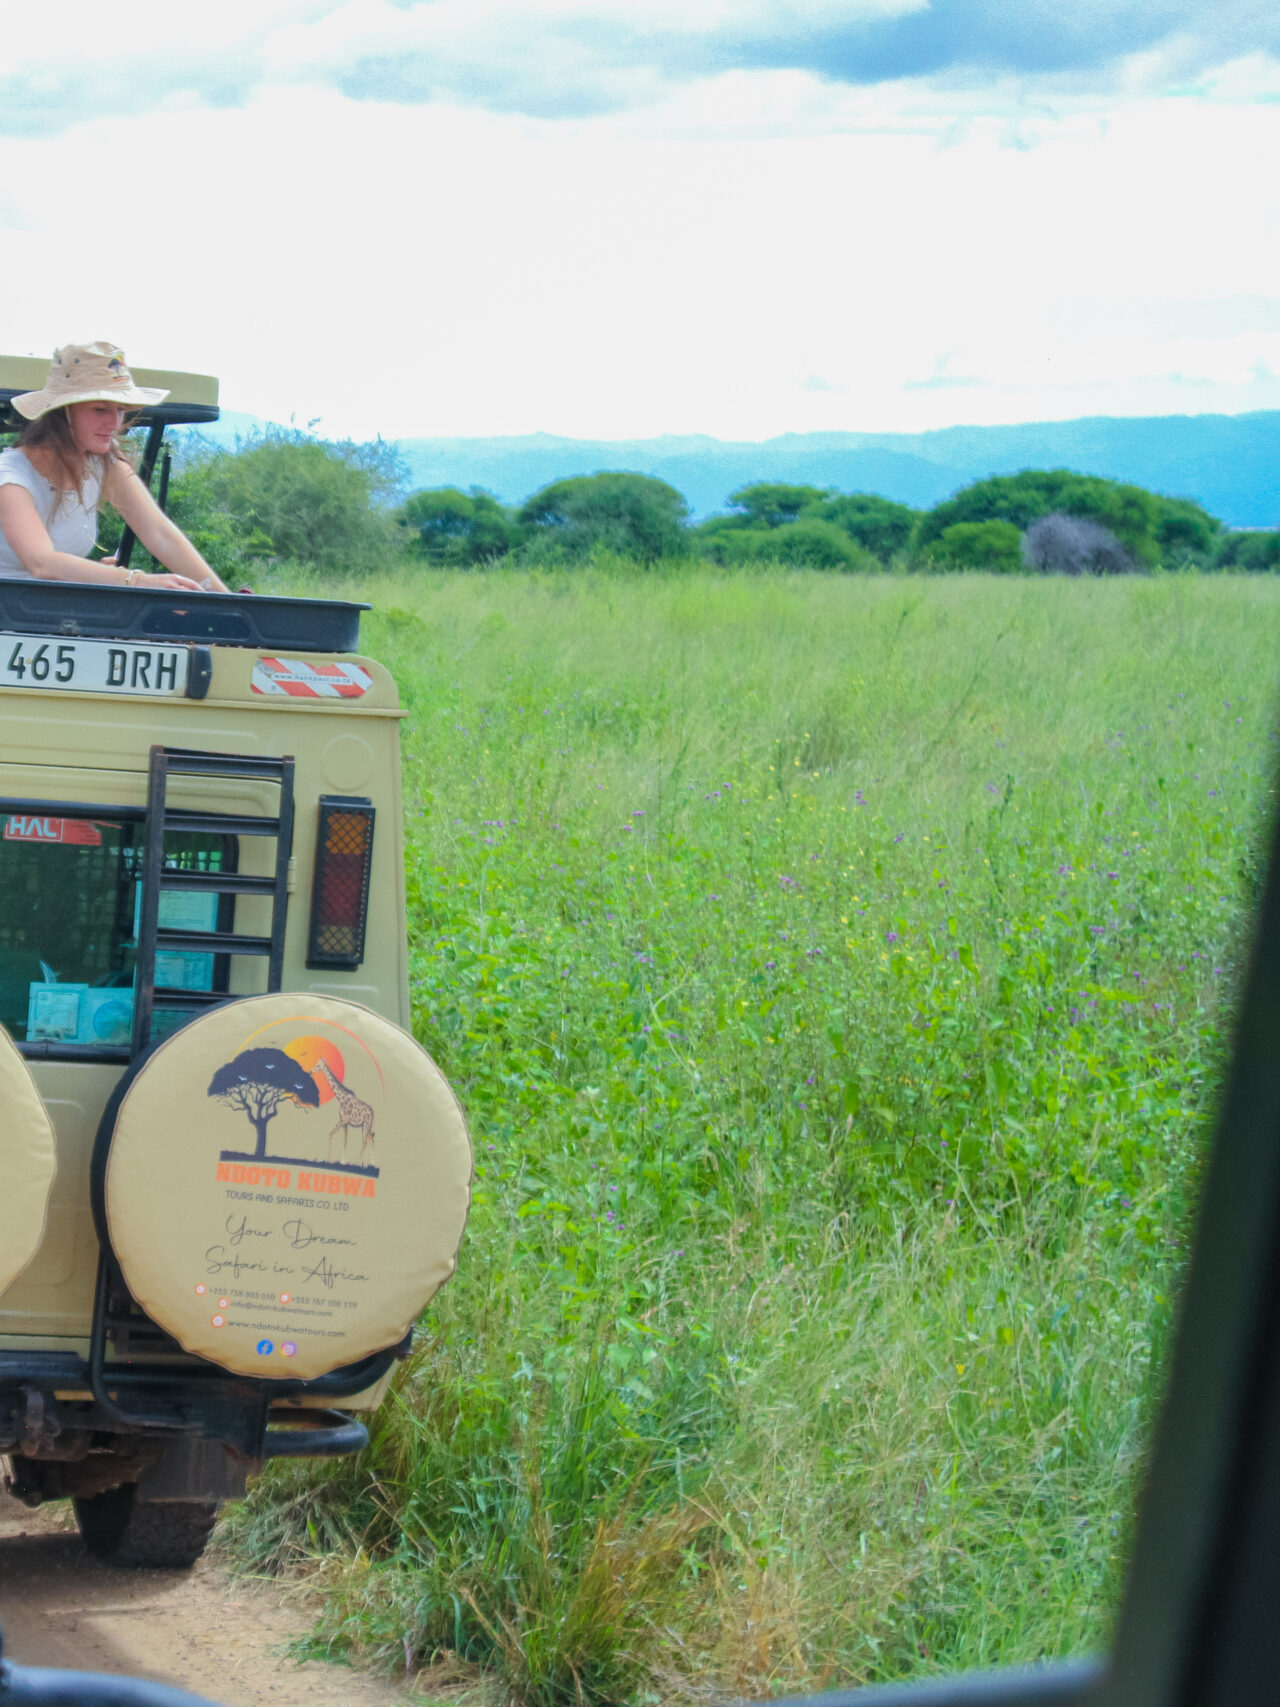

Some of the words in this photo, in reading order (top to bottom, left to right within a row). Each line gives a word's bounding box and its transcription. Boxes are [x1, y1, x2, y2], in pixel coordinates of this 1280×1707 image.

[7, 642, 76, 682] 465
[105, 648, 178, 691] DRH
[9, 816, 57, 837] HAL
[216, 1162, 290, 1189] NDOTO
[297, 1172, 376, 1198] KUBWA
[226, 1190, 253, 1201] TOURS
[256, 1193, 273, 1204] AND
[276, 1195, 314, 1208] SAFARIS
[333, 1200, 349, 1212] LTD
[225, 1214, 272, 1245] Your
[282, 1218, 357, 1249] Dream
[205, 1245, 267, 1280] Safari
[273, 1261, 294, 1274] in
[301, 1256, 369, 1289] Africa
[227, 1319, 345, 1338] www.ndotokubwatours.com
